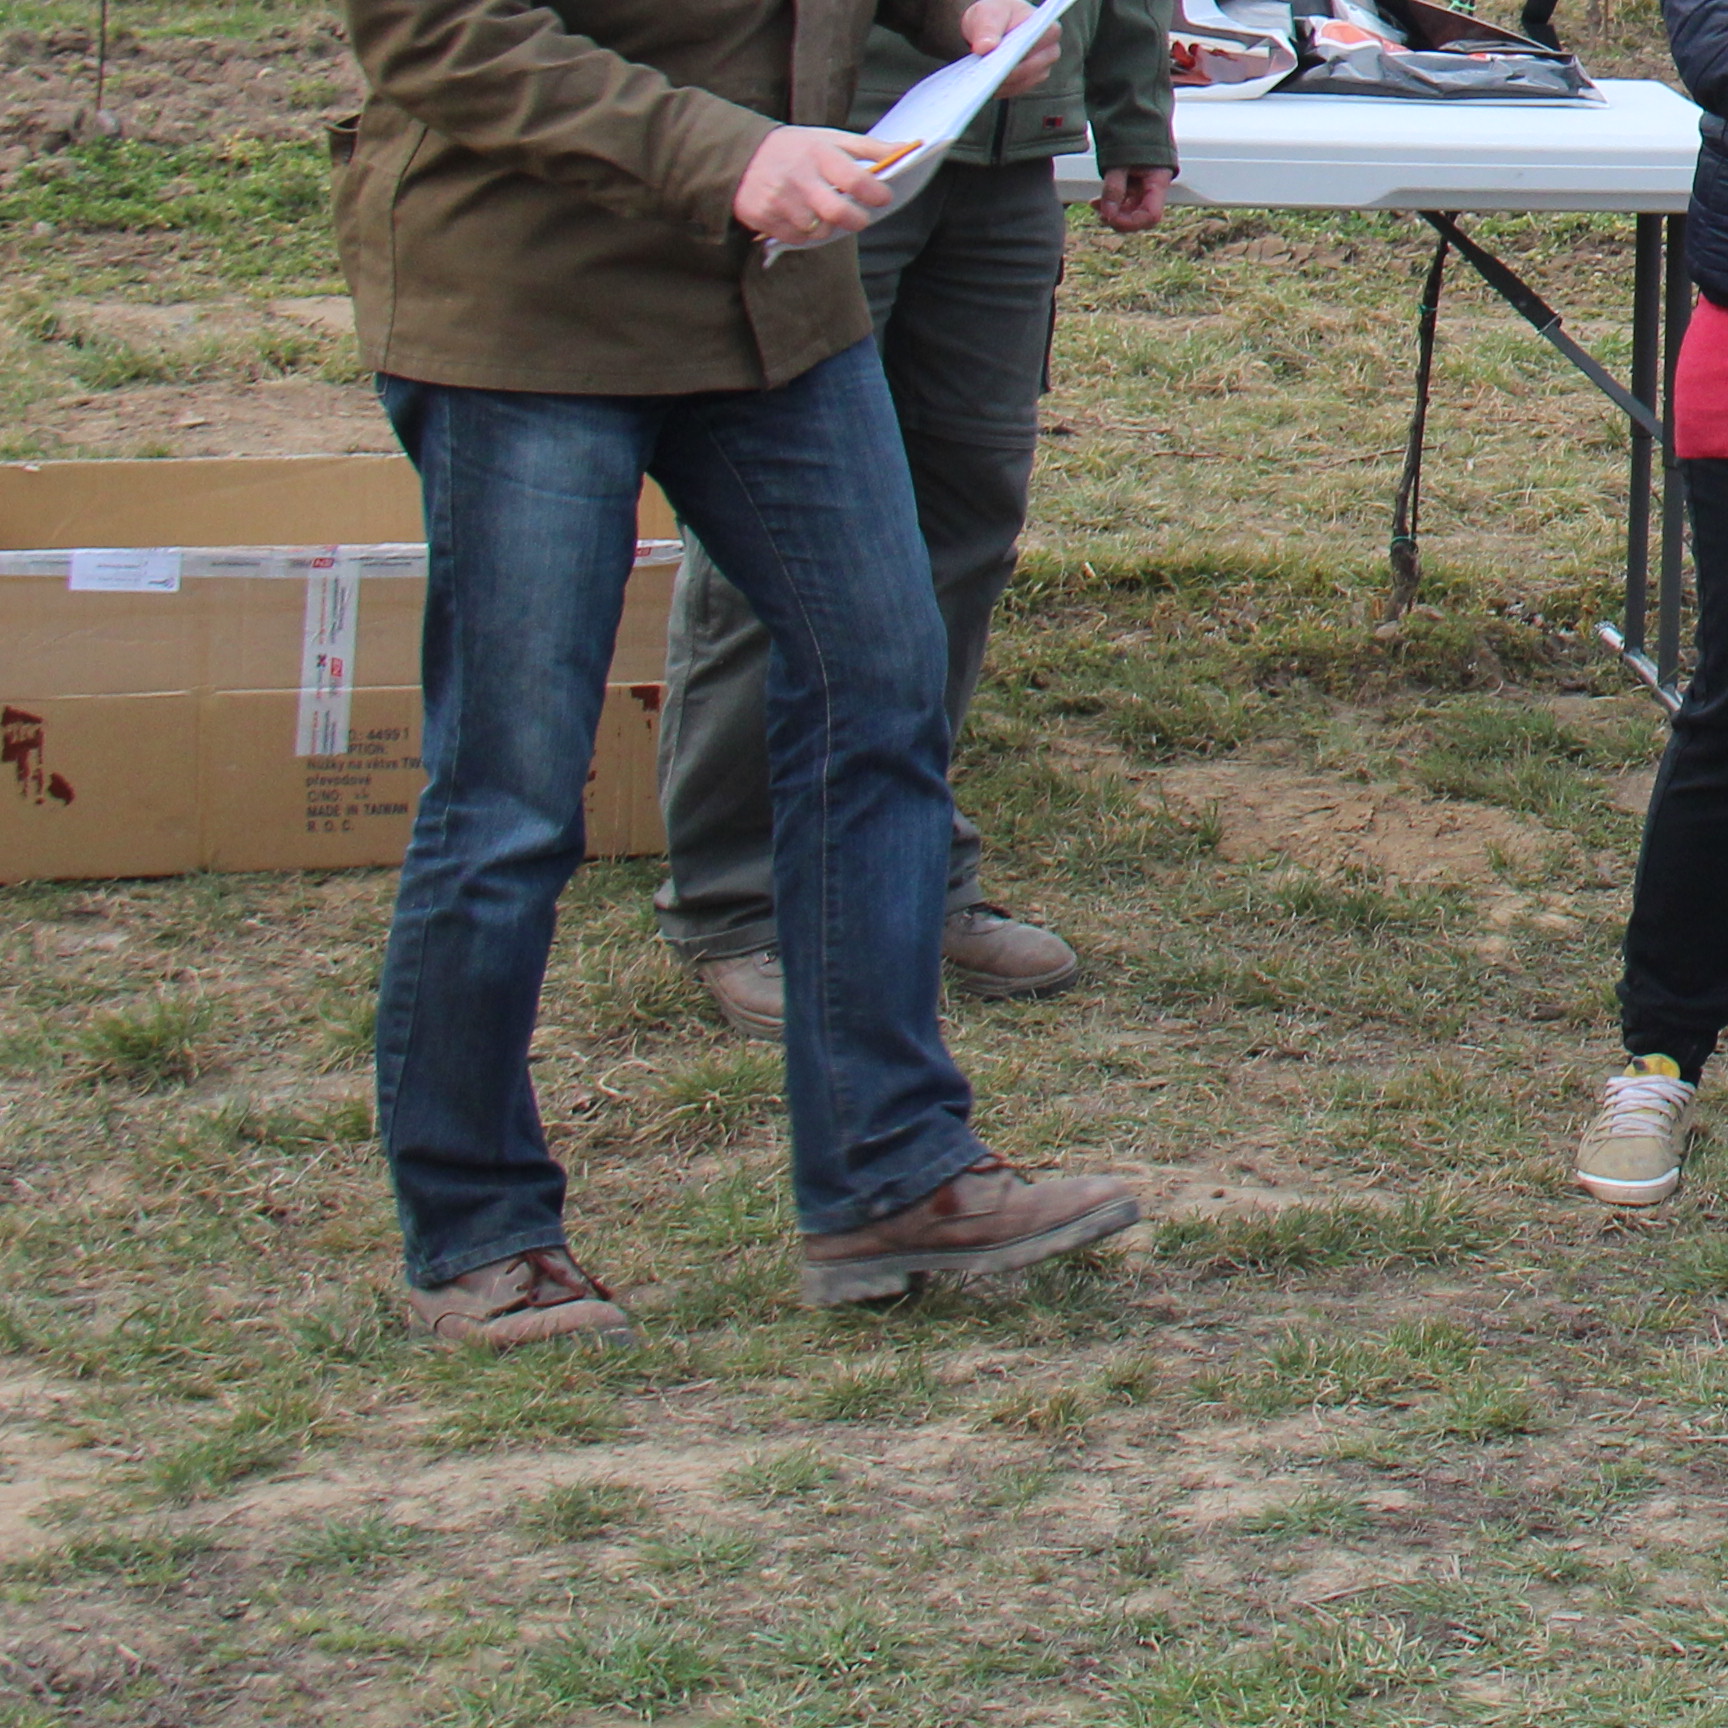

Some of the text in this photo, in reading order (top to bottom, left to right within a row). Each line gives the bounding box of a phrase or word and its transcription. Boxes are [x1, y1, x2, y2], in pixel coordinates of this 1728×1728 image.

[307, 802, 408, 817] MADE IN TAIWAN
